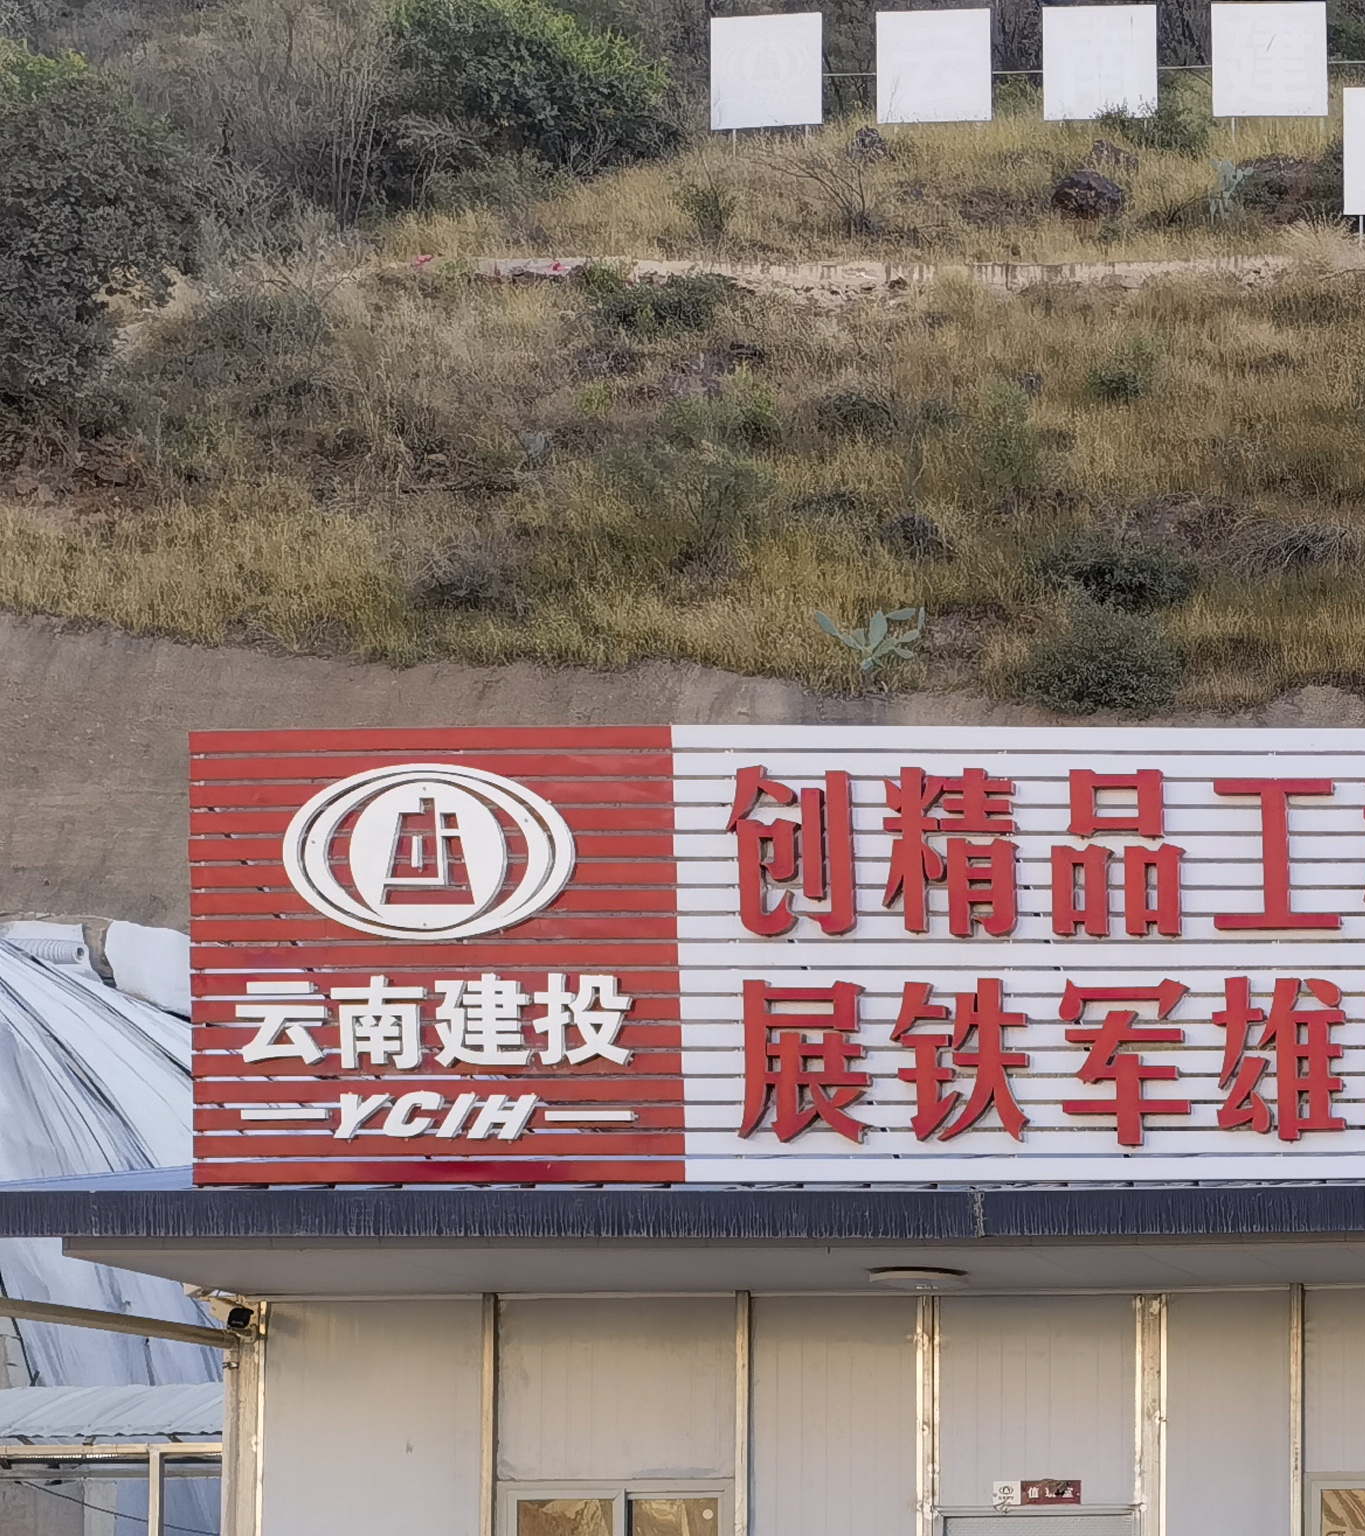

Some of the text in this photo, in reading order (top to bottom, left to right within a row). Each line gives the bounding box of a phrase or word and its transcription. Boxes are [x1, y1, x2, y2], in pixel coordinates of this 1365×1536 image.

[235, 973, 634, 1070] 云南建投
[333, 1091, 541, 1142] YCIH
